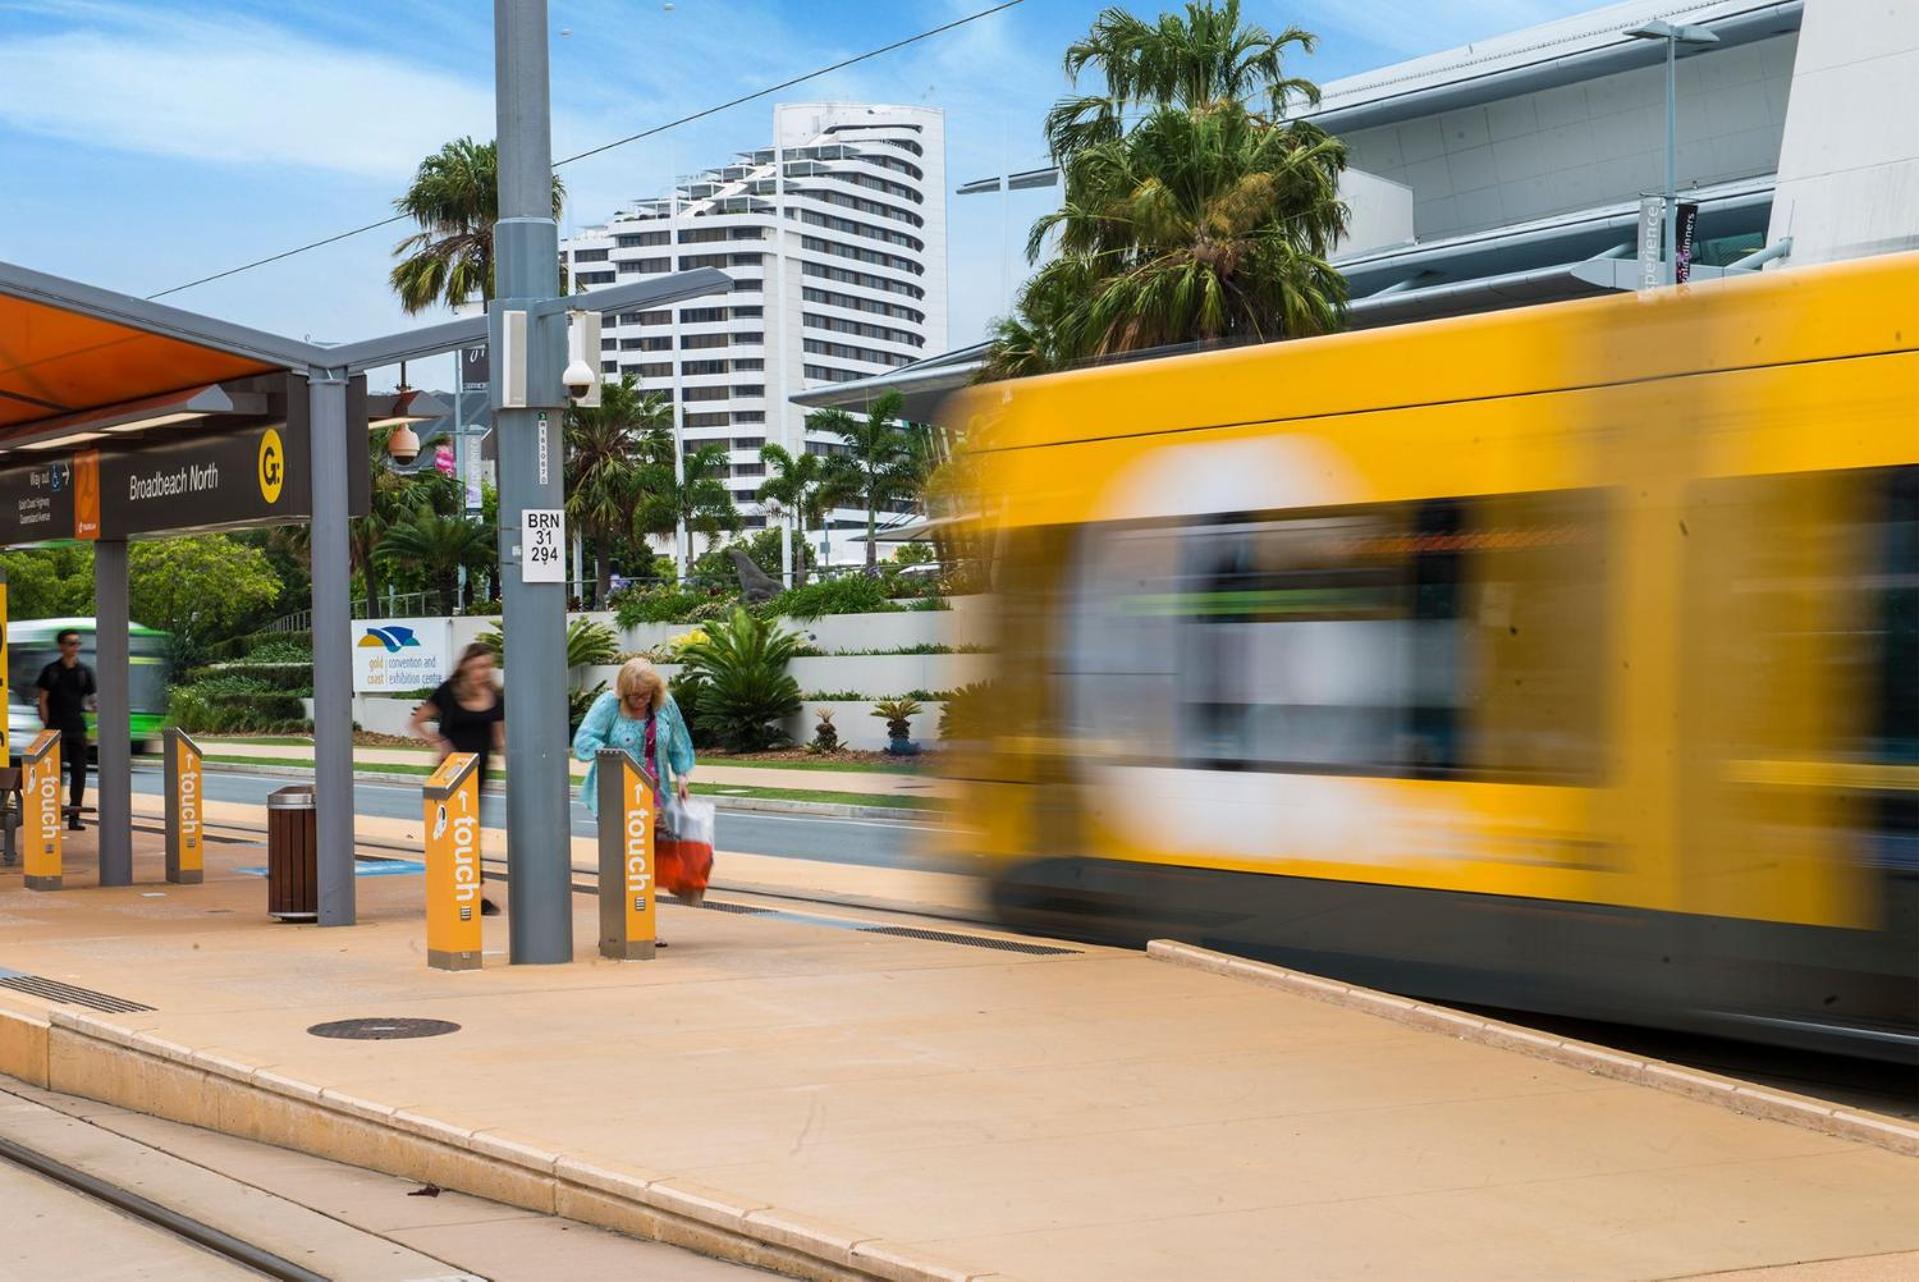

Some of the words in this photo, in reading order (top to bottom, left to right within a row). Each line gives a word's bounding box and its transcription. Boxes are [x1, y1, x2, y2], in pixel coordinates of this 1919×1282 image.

[1643, 205, 1659, 291] perience
[129, 466, 187, 501] Broadbeach
[189, 461, 219, 492] North
[528, 513, 560, 528] BRN
[536, 530, 552, 545] 31
[531, 546, 558, 562] 294
[41, 775, 61, 839] touch
[181, 772, 199, 834] touch
[453, 815, 480, 902] touch
[628, 808, 651, 892] touch
